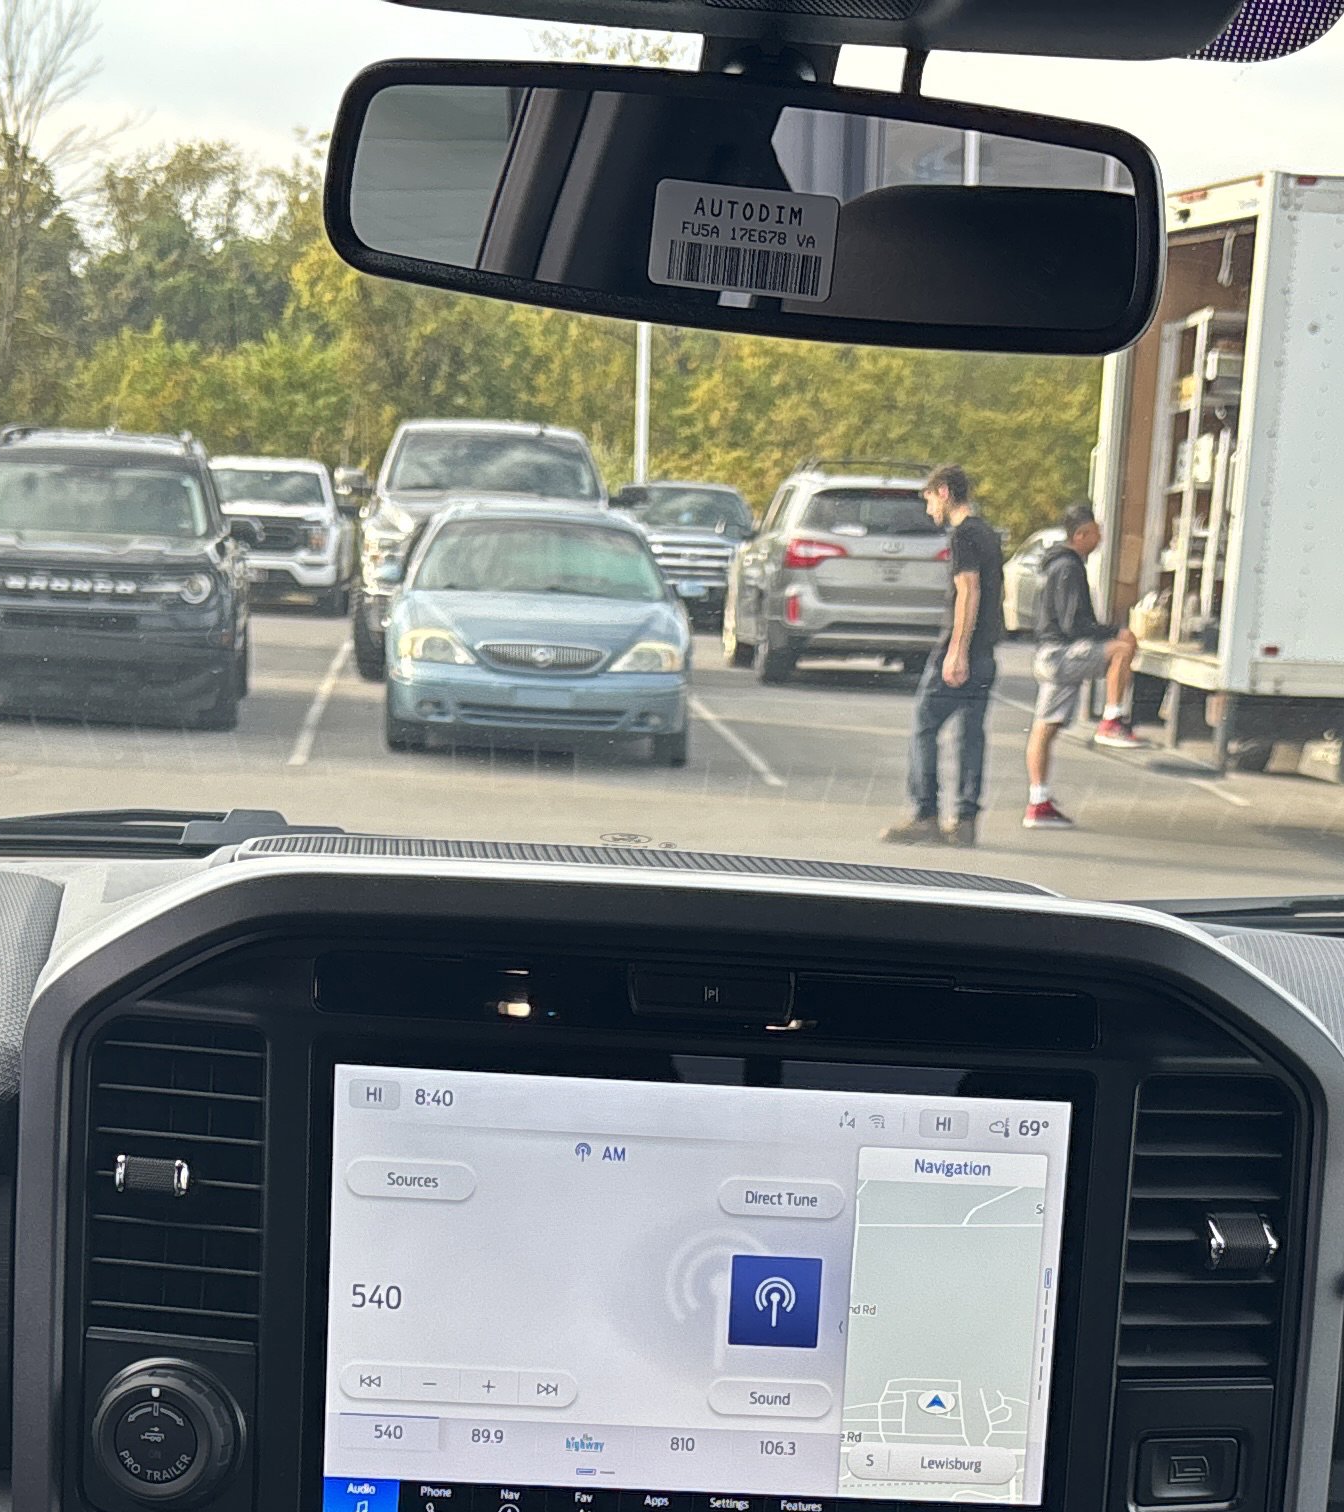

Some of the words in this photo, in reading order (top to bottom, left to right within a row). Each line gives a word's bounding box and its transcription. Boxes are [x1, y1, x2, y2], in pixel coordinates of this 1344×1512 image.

[694, 197, 803, 226] AUTODIM
[681, 221, 720, 238] FU5A
[730, 227, 787, 245] 17E678
[796, 234, 816, 248] VA
[366, 1086, 383, 1103] HI
[415, 1088, 454, 1107] 8:40
[935, 1116, 951, 1131] HI
[1019, 1119, 1050, 1137] 69°
[602, 1146, 626, 1161] AM
[914, 1158, 991, 1177] Navigation
[387, 1172, 439, 1188] Sources
[745, 1190, 783, 1206] Direct
[786, 1192, 817, 1207] Tune
[351, 1283, 402, 1310] 540
[862, 1305, 876, 1316] Rd
[749, 1391, 791, 1406] Sound
[373, 1424, 404, 1440] 540
[471, 1428, 504, 1444] 89.9
[847, 1432, 862, 1443] Rd
[565, 1436, 605, 1453] highway
[670, 1436, 696, 1452] 810
[760, 1440, 796, 1456] 106.3
[119, 1450, 141, 1474] PRO
[146, 1454, 192, 1481] TRAILER
[866, 1454, 874, 1467] S
[920, 1456, 982, 1473] Lewisburg
[347, 1483, 376, 1495] Audio
[420, 1485, 452, 1498] Phone
[500, 1489, 520, 1501] Nav
[574, 1492, 593, 1504] Fav
[644, 1495, 669, 1508] Apps
[710, 1497, 749, 1511] Settings
[781, 1500, 822, 1512] Features
